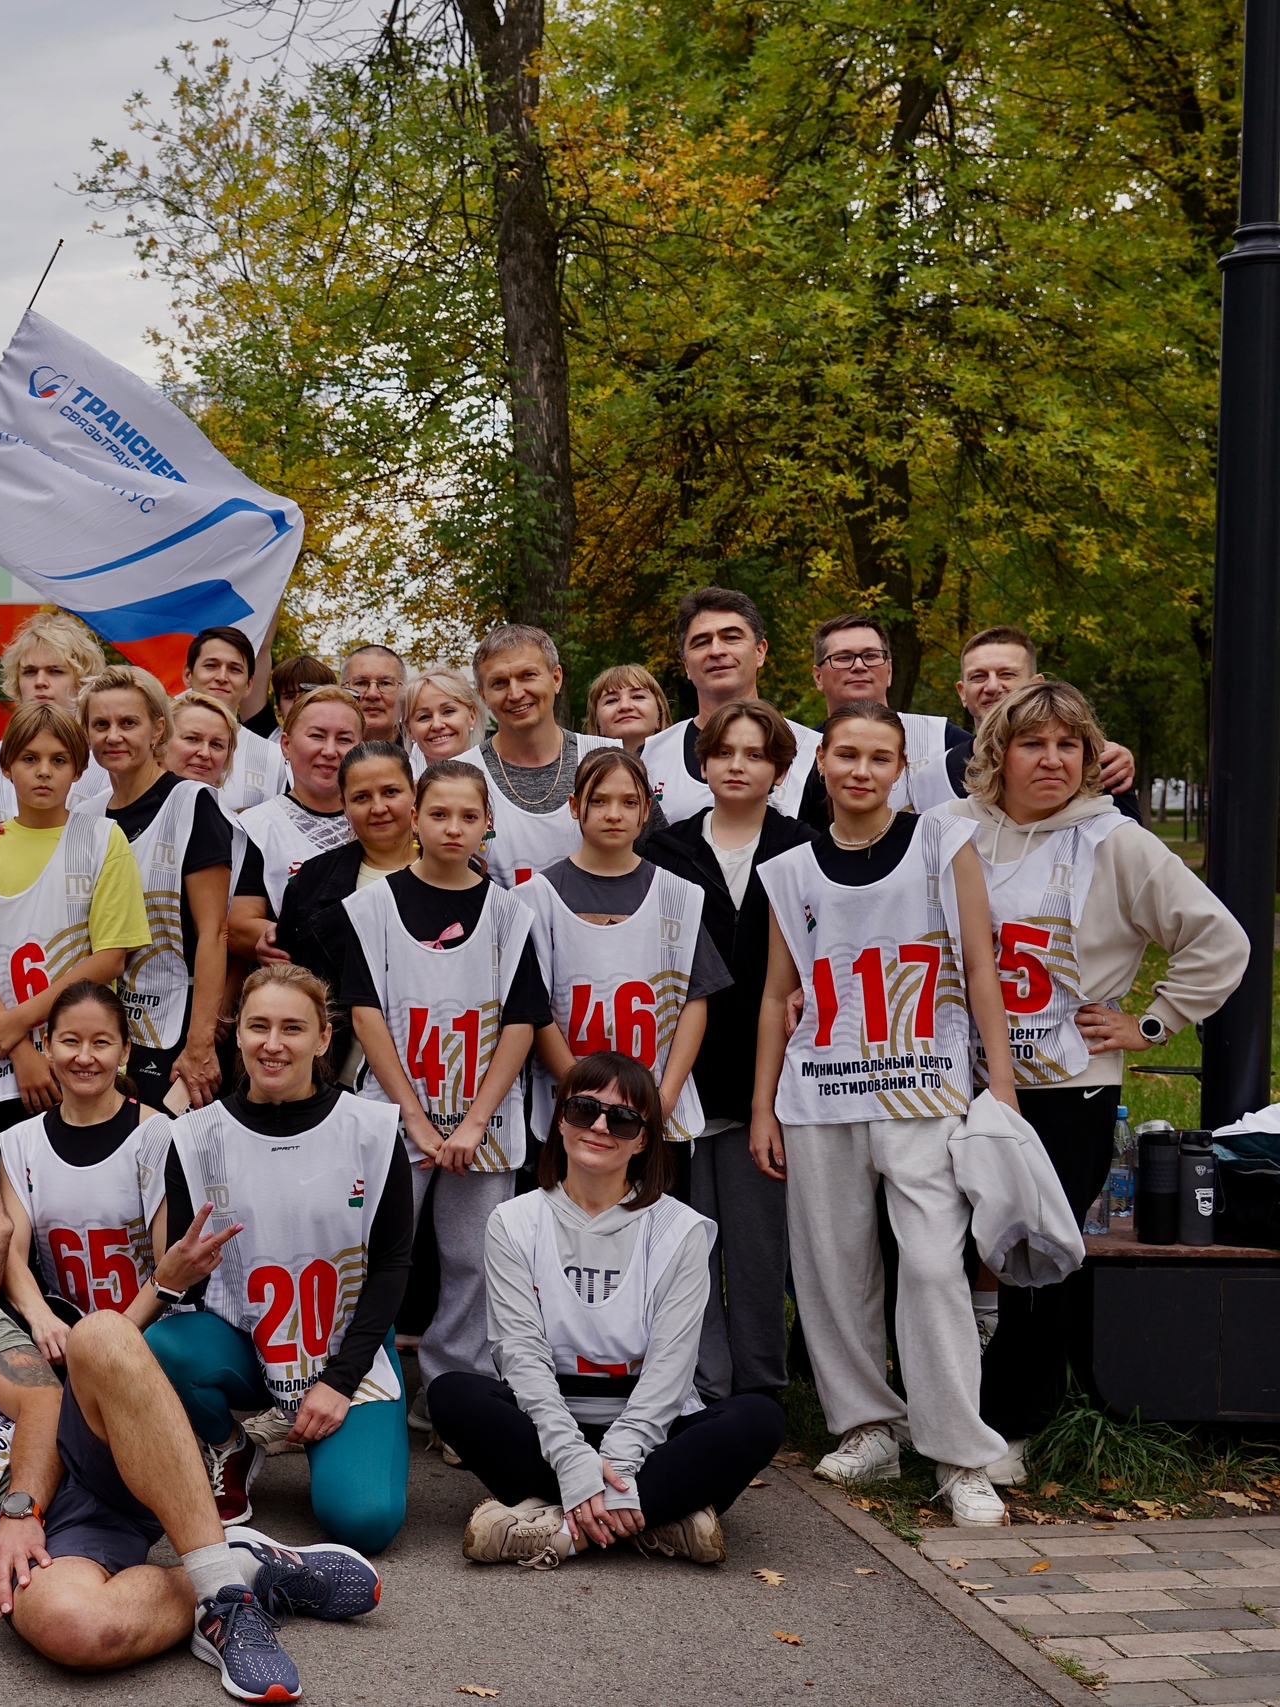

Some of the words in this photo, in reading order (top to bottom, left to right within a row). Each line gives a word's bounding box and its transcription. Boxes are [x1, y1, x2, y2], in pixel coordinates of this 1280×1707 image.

[124, 991, 160, 1008] центр
[568, 981, 657, 1069] 46
[407, 1007, 480, 1098] 41
[801, 1053, 915, 1078] Муниципальный
[920, 1055, 953, 1071] центр
[818, 1076, 916, 1097] тестирования
[921, 1073, 941, 1089] ГТО
[48, 1228, 140, 1312] 65
[247, 1258, 338, 1364] 20
